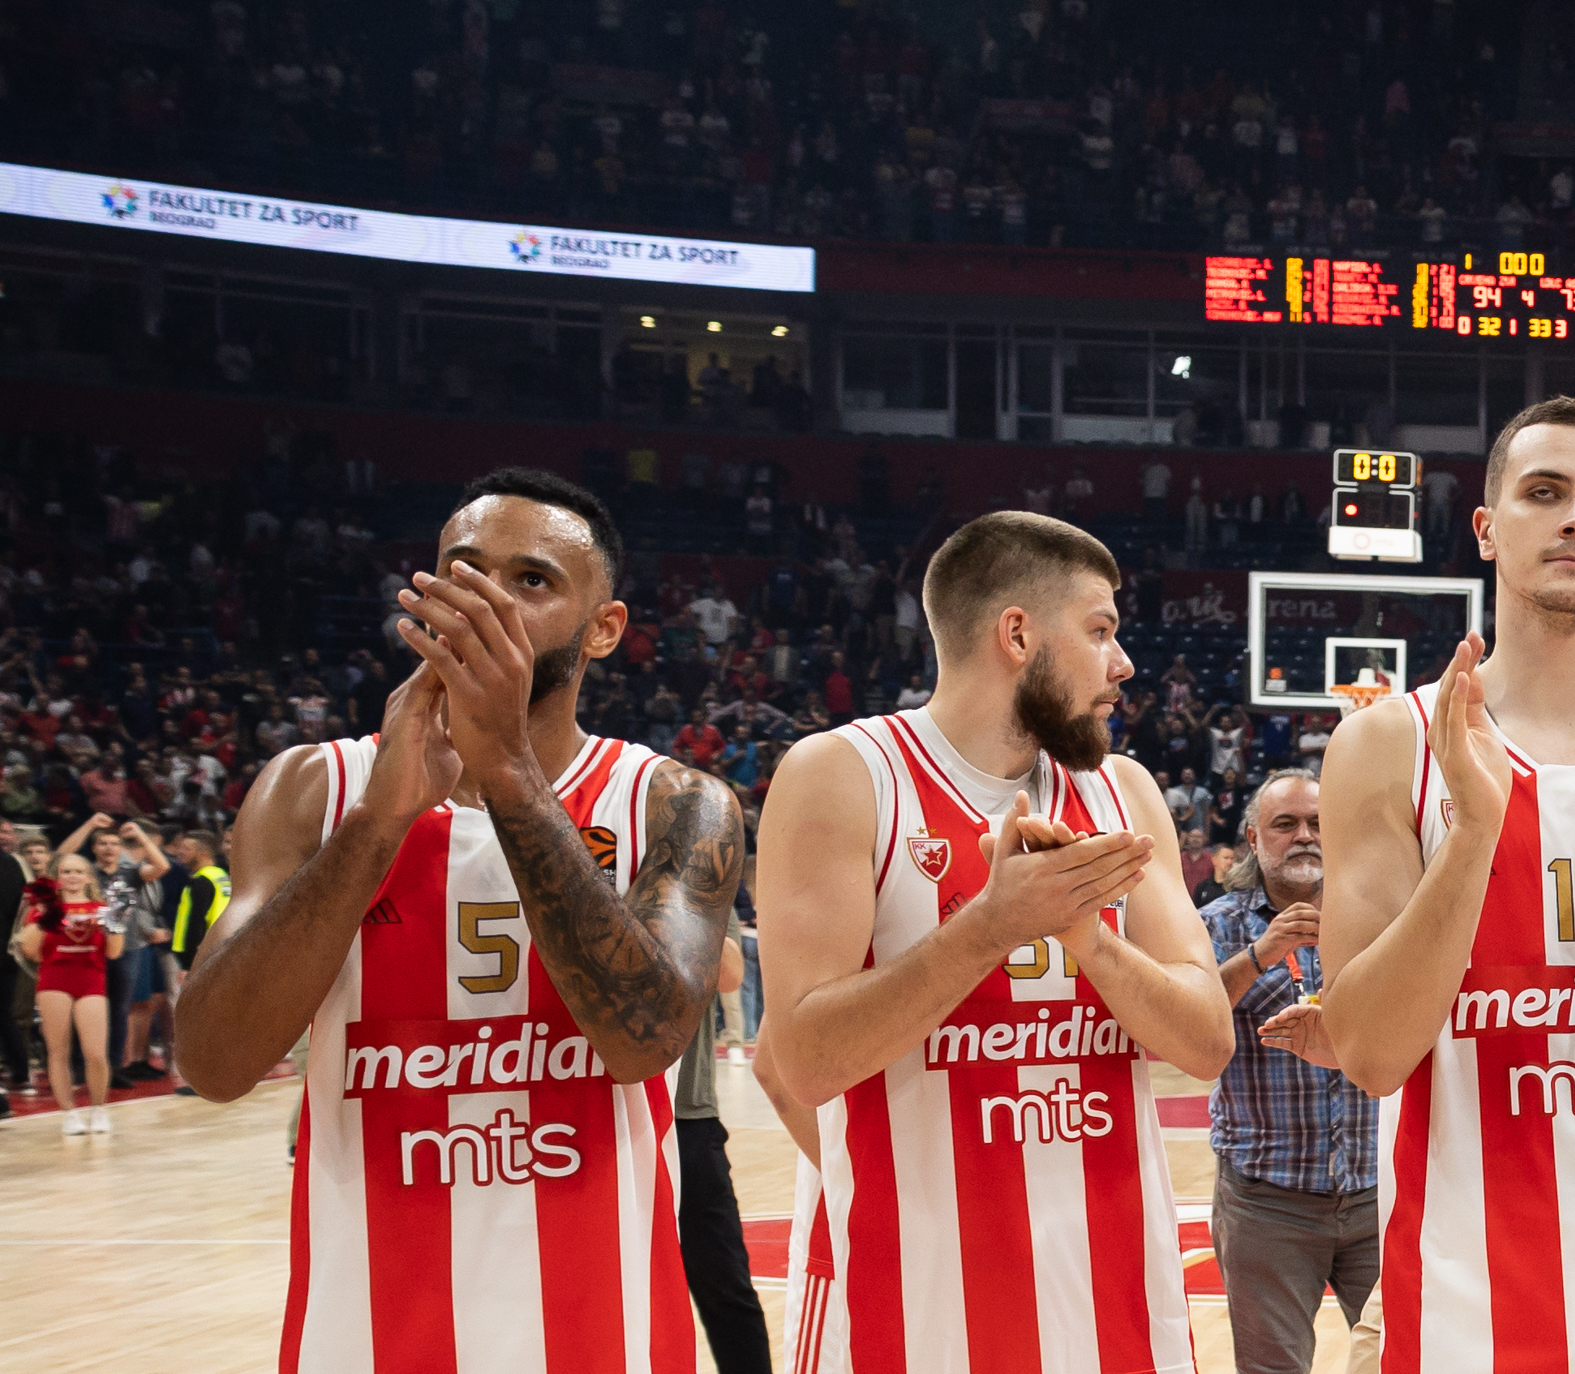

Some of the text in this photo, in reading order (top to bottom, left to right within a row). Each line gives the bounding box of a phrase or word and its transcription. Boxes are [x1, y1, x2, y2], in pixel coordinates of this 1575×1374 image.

[149, 191, 358, 230] FAKULTET ZA SPORT
[551, 236, 738, 265] FAKULTET ZA SPORT
[1473, 286, 1501, 308] 94
[1521, 290, 1535, 307] 4
[1457, 316, 1471, 335] 0
[1478, 317, 1501, 336] 32
[1528, 319, 1552, 337] 33
[458, 901, 520, 994] 5
[981, 1081, 1113, 1144] mts
[401, 1112, 582, 1186] mts
